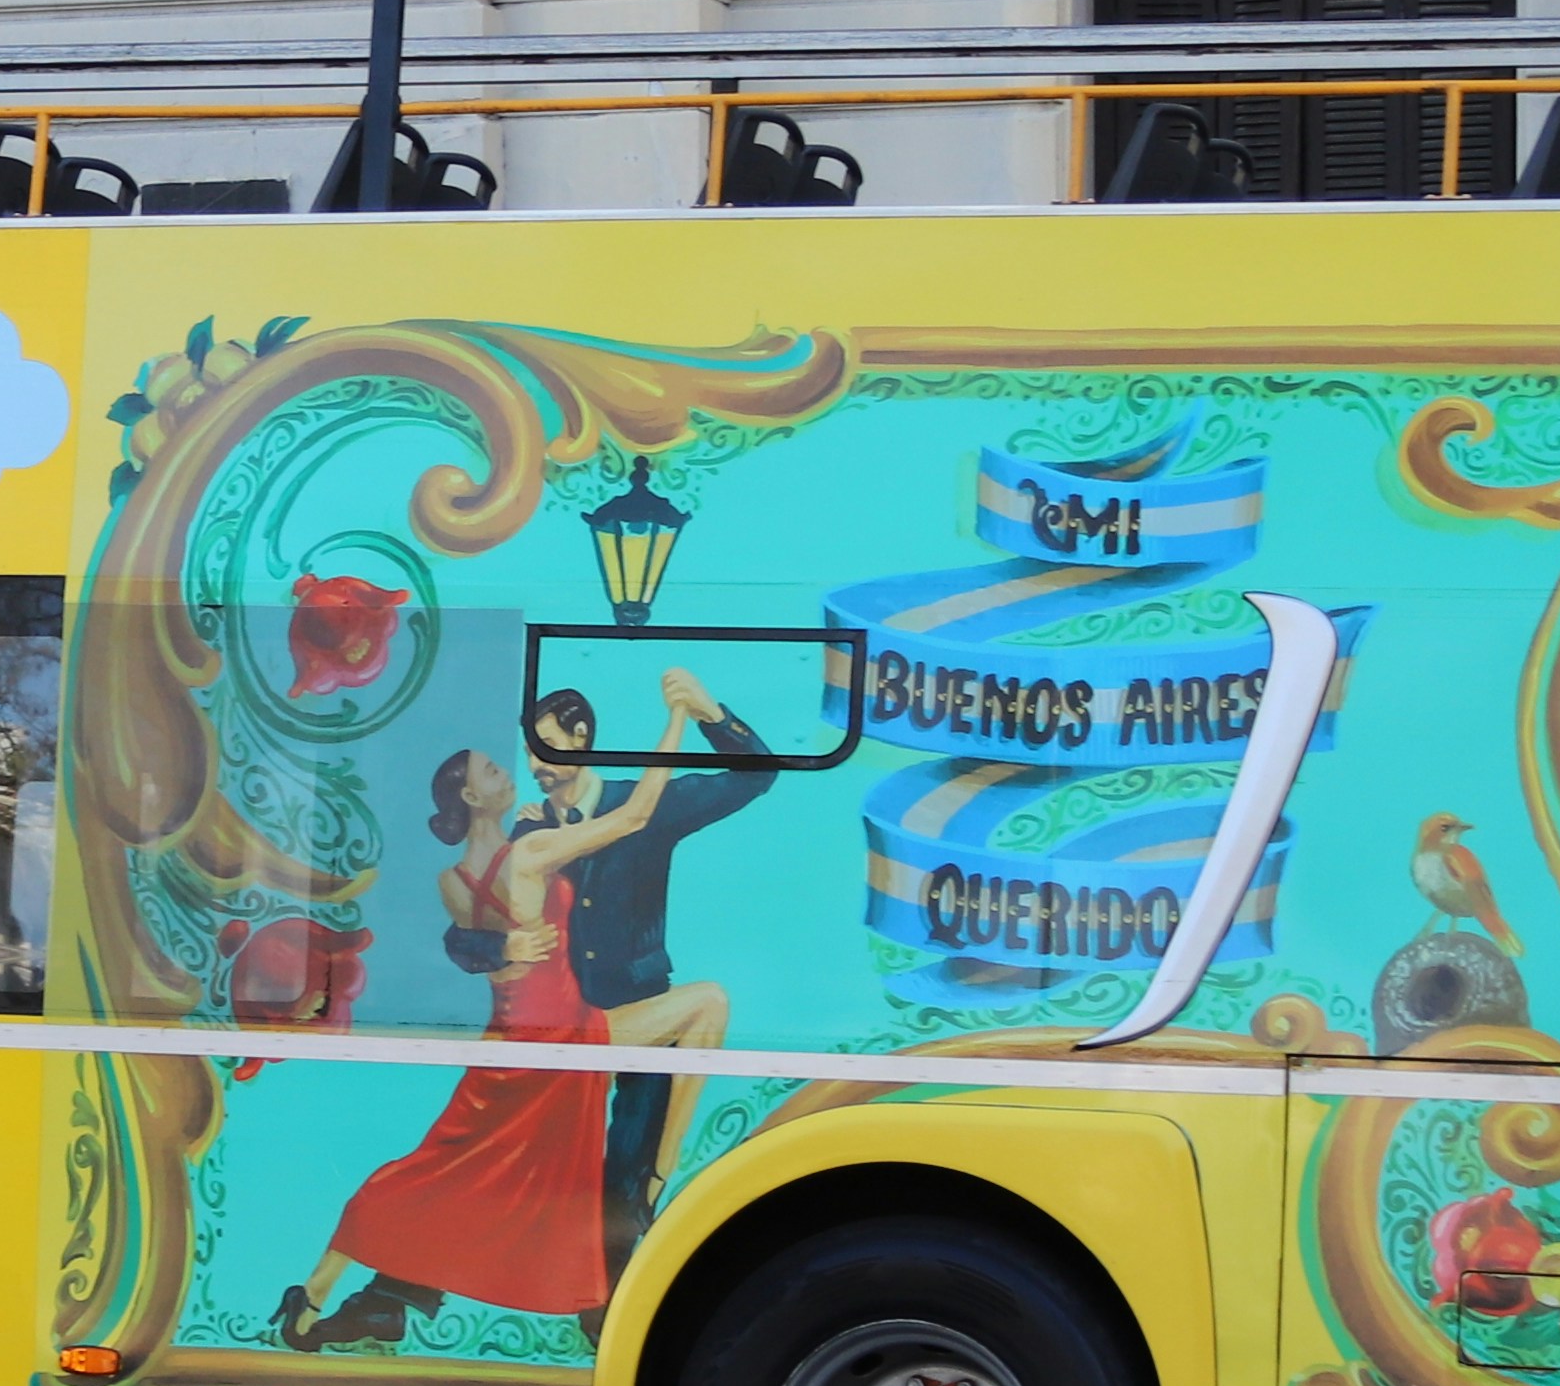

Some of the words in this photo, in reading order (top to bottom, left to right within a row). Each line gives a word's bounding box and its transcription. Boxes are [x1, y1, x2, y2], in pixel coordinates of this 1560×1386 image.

[871, 649, 1094, 747] BUENOS
[1119, 668, 1271, 746] AIRES
[928, 863, 1179, 959] QUERIDO
